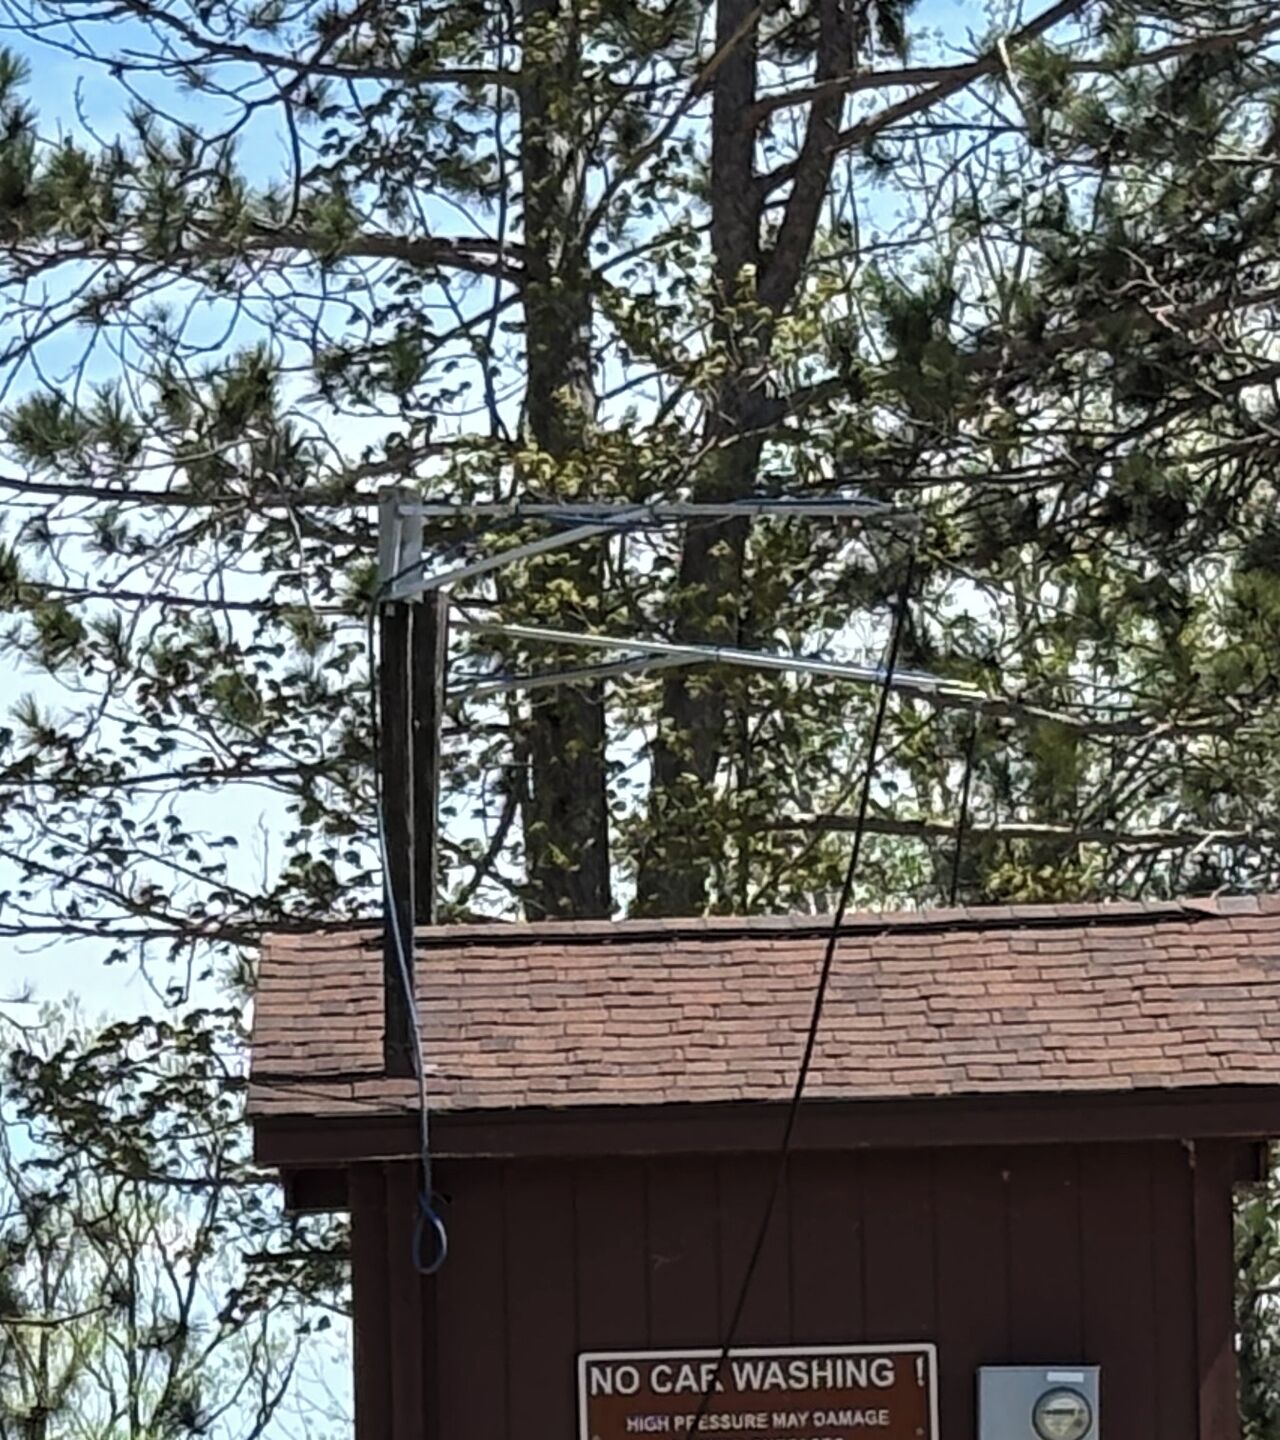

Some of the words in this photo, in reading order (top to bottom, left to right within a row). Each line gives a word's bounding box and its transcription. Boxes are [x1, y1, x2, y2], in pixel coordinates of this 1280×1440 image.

[591, 1366, 639, 1395] NO
[732, 1359, 894, 1391] WASHING
[627, 1416, 669, 1431] HIGH
[773, 1412, 808, 1427] MAY
[813, 1410, 889, 1427] DAMAGE
